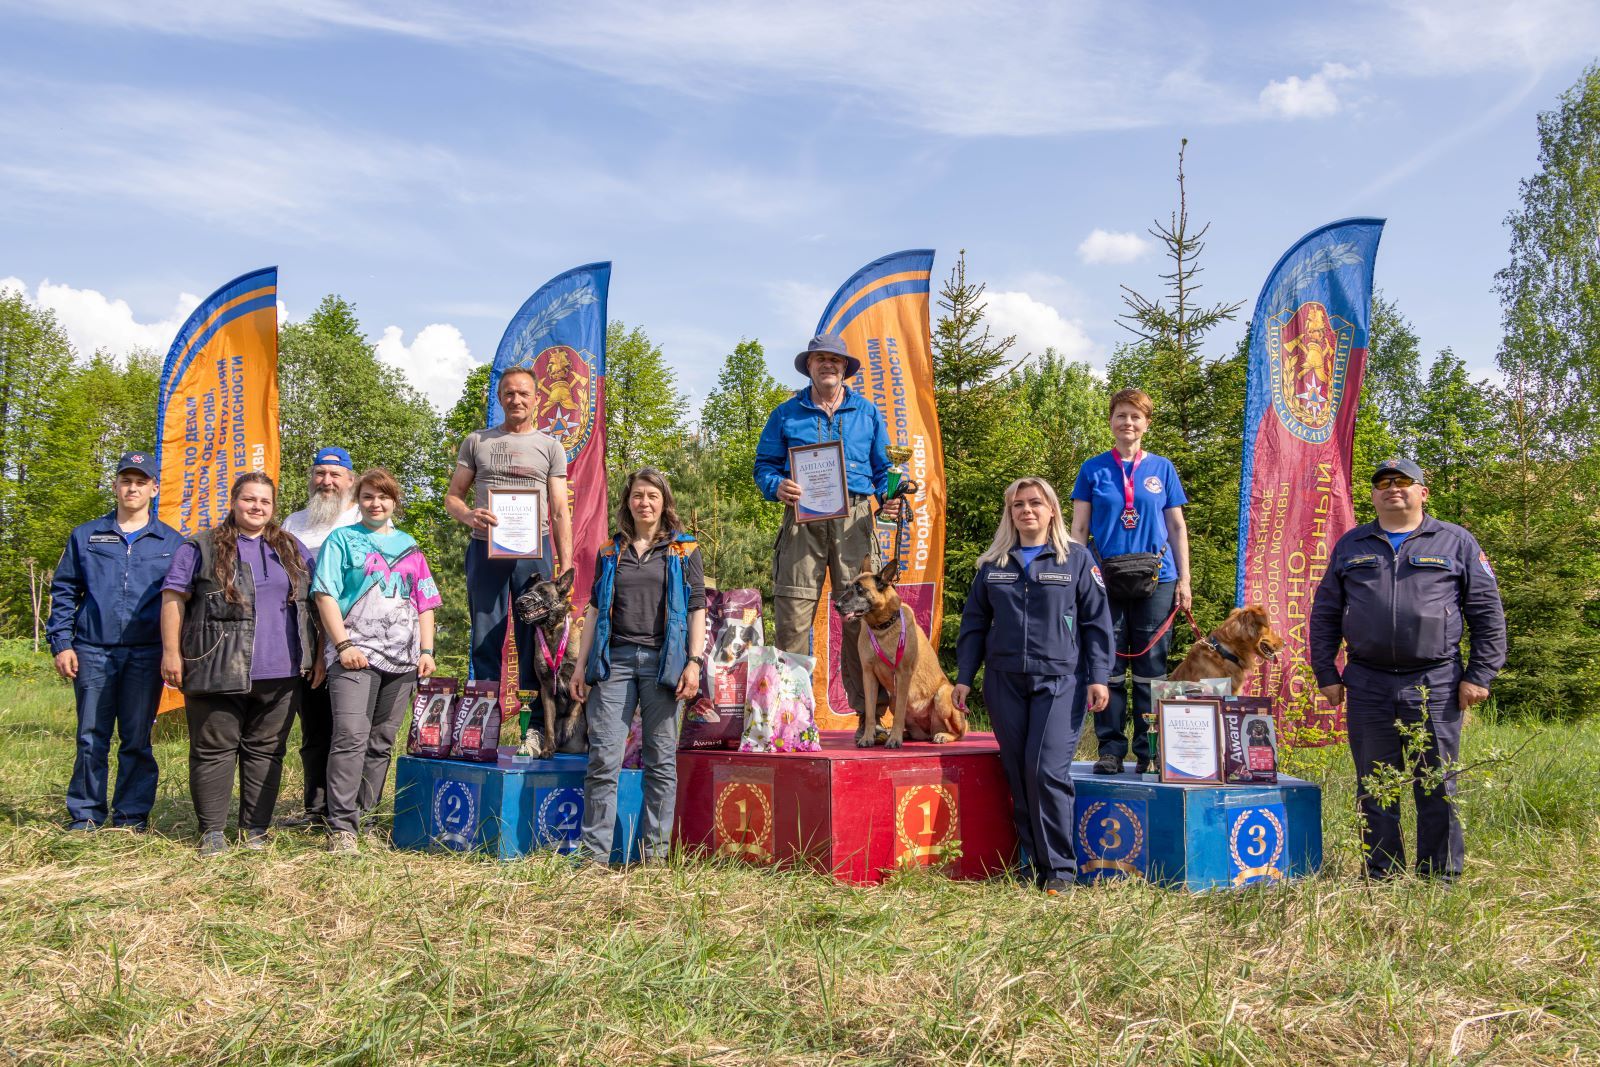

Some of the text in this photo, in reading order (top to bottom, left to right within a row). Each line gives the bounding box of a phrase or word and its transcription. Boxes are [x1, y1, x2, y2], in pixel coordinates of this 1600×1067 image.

[867, 338, 888, 428] ИТУАЦИЯМ
[886, 338, 908, 446] ЕЗОПАСНОСТИ
[232, 356, 246, 470] БЕЗОПАСНОСТИ
[198, 387, 216, 529] ДАНСКОЙ ОБОРОНЫ,
[216, 358, 228, 526] ЫЧАЙНЫМ СИТУАЦИЯМ
[252, 444, 264, 472] КВЫ
[180, 397, 200, 538] АРТАМЕНТ ПО ДЕЛАМ
[800, 460, 836, 472] ДИПЛОМ
[913, 434, 928, 570] ГОРОДА МОСКВЫ
[1252, 488, 1274, 574] КАЗЕННОЕ
[1268, 482, 1290, 624] ГОРОДА МОСКВЫ
[410, 694, 428, 738] Award
[452, 698, 474, 740] Award
[1168, 720, 1209, 728] ДИПЛОМ
[1226, 715, 1242, 763] Award
[446, 794, 462, 824] 2
[558, 802, 578, 830] 2
[735, 798, 752, 832] 1
[916, 800, 936, 835] 1
[1099, 818, 1122, 849] 3
[1247, 824, 1266, 856] 3
